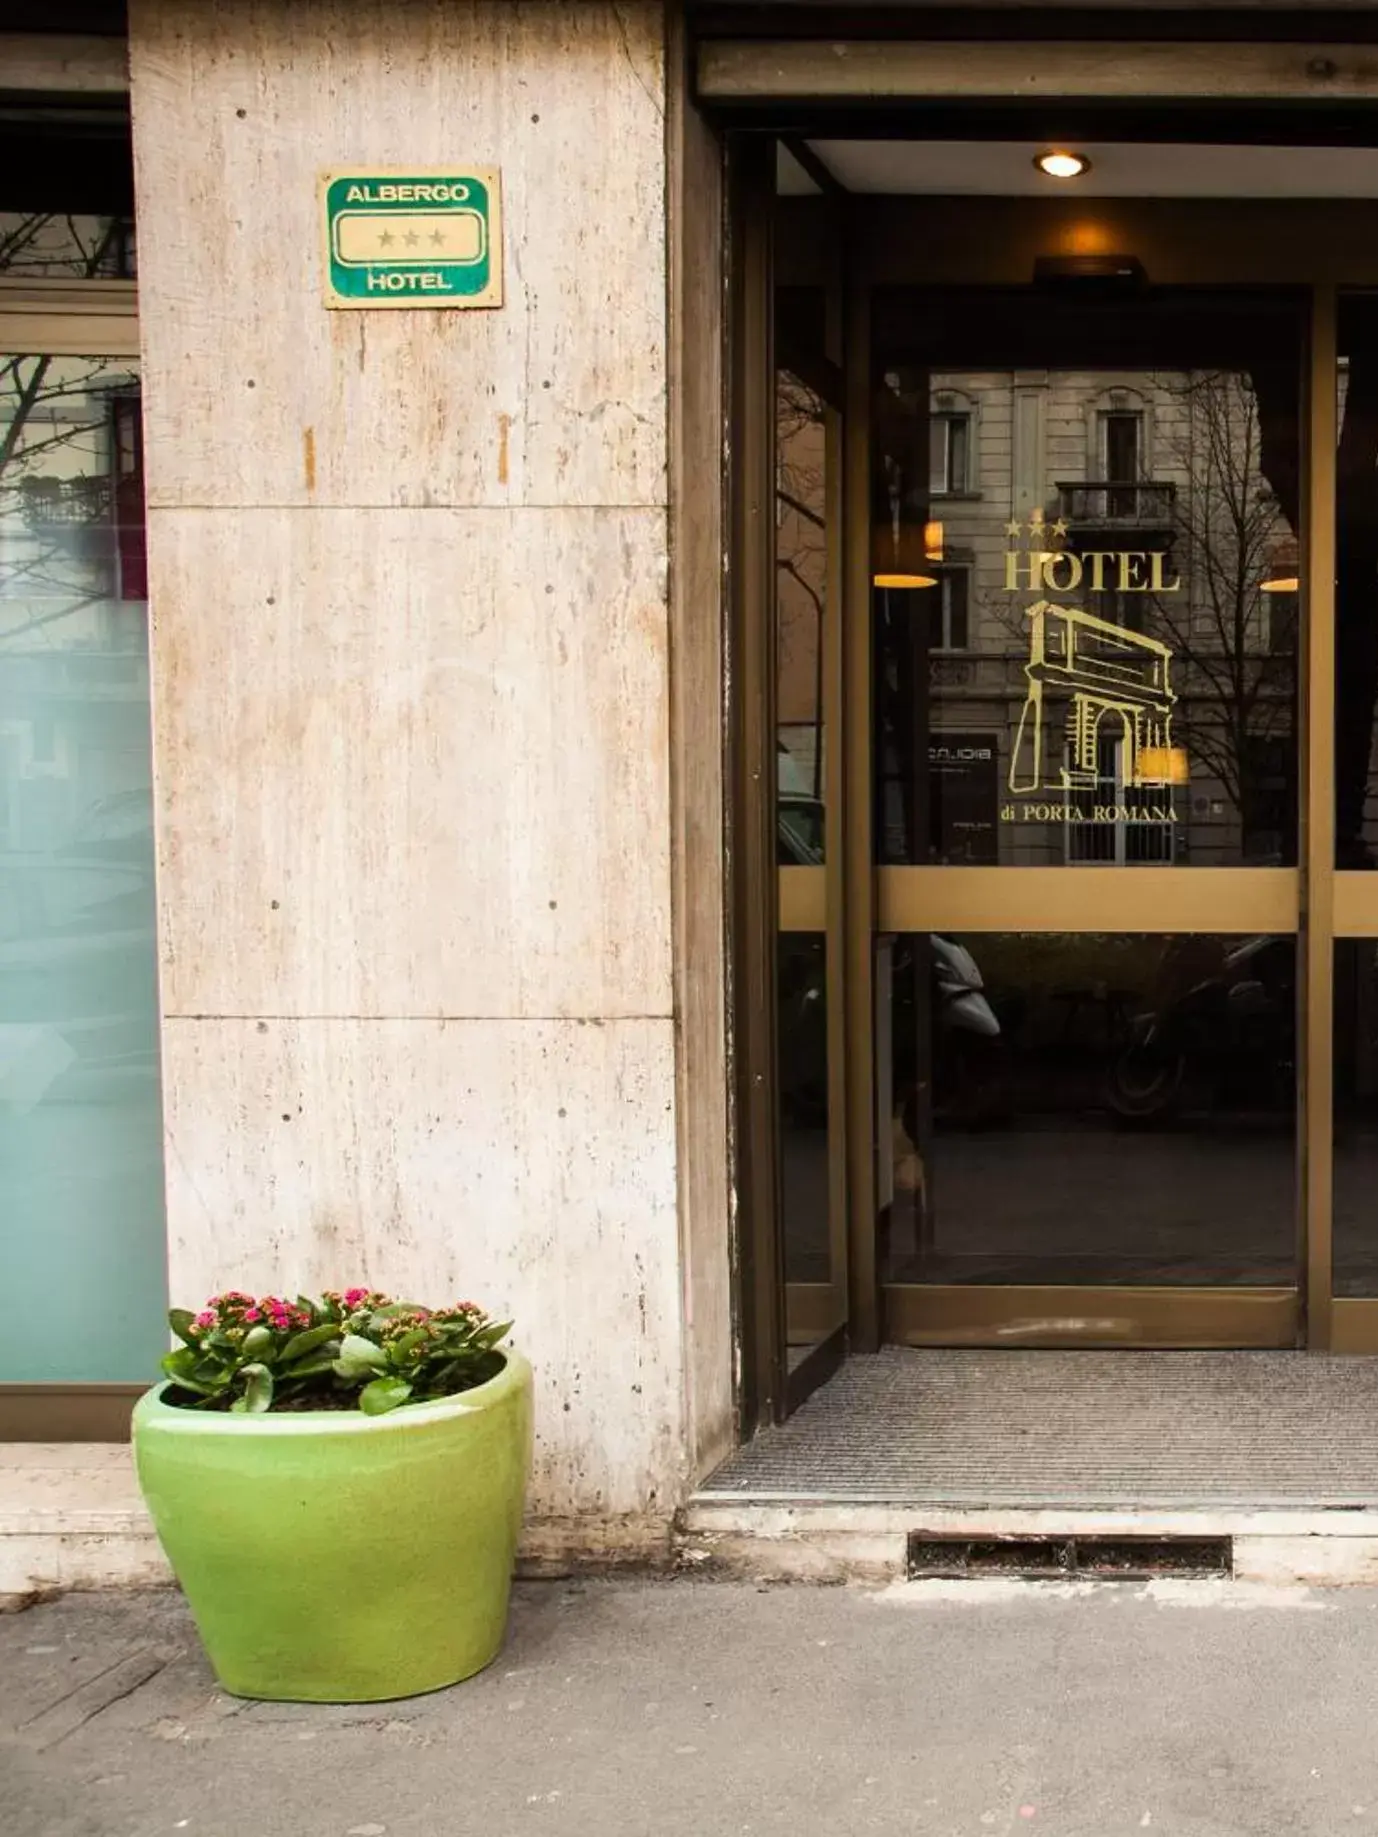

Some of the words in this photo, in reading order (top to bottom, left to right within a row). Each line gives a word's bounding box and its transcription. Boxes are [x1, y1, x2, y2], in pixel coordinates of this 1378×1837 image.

[346, 184, 470, 202] ALBERGO
[367, 271, 453, 291] HOTEL
[1002, 551, 1181, 592] HOTEL
[1000, 804, 1015, 821] di
[1023, 804, 1084, 821] PORTA
[1093, 805, 1178, 822] ROMANA
